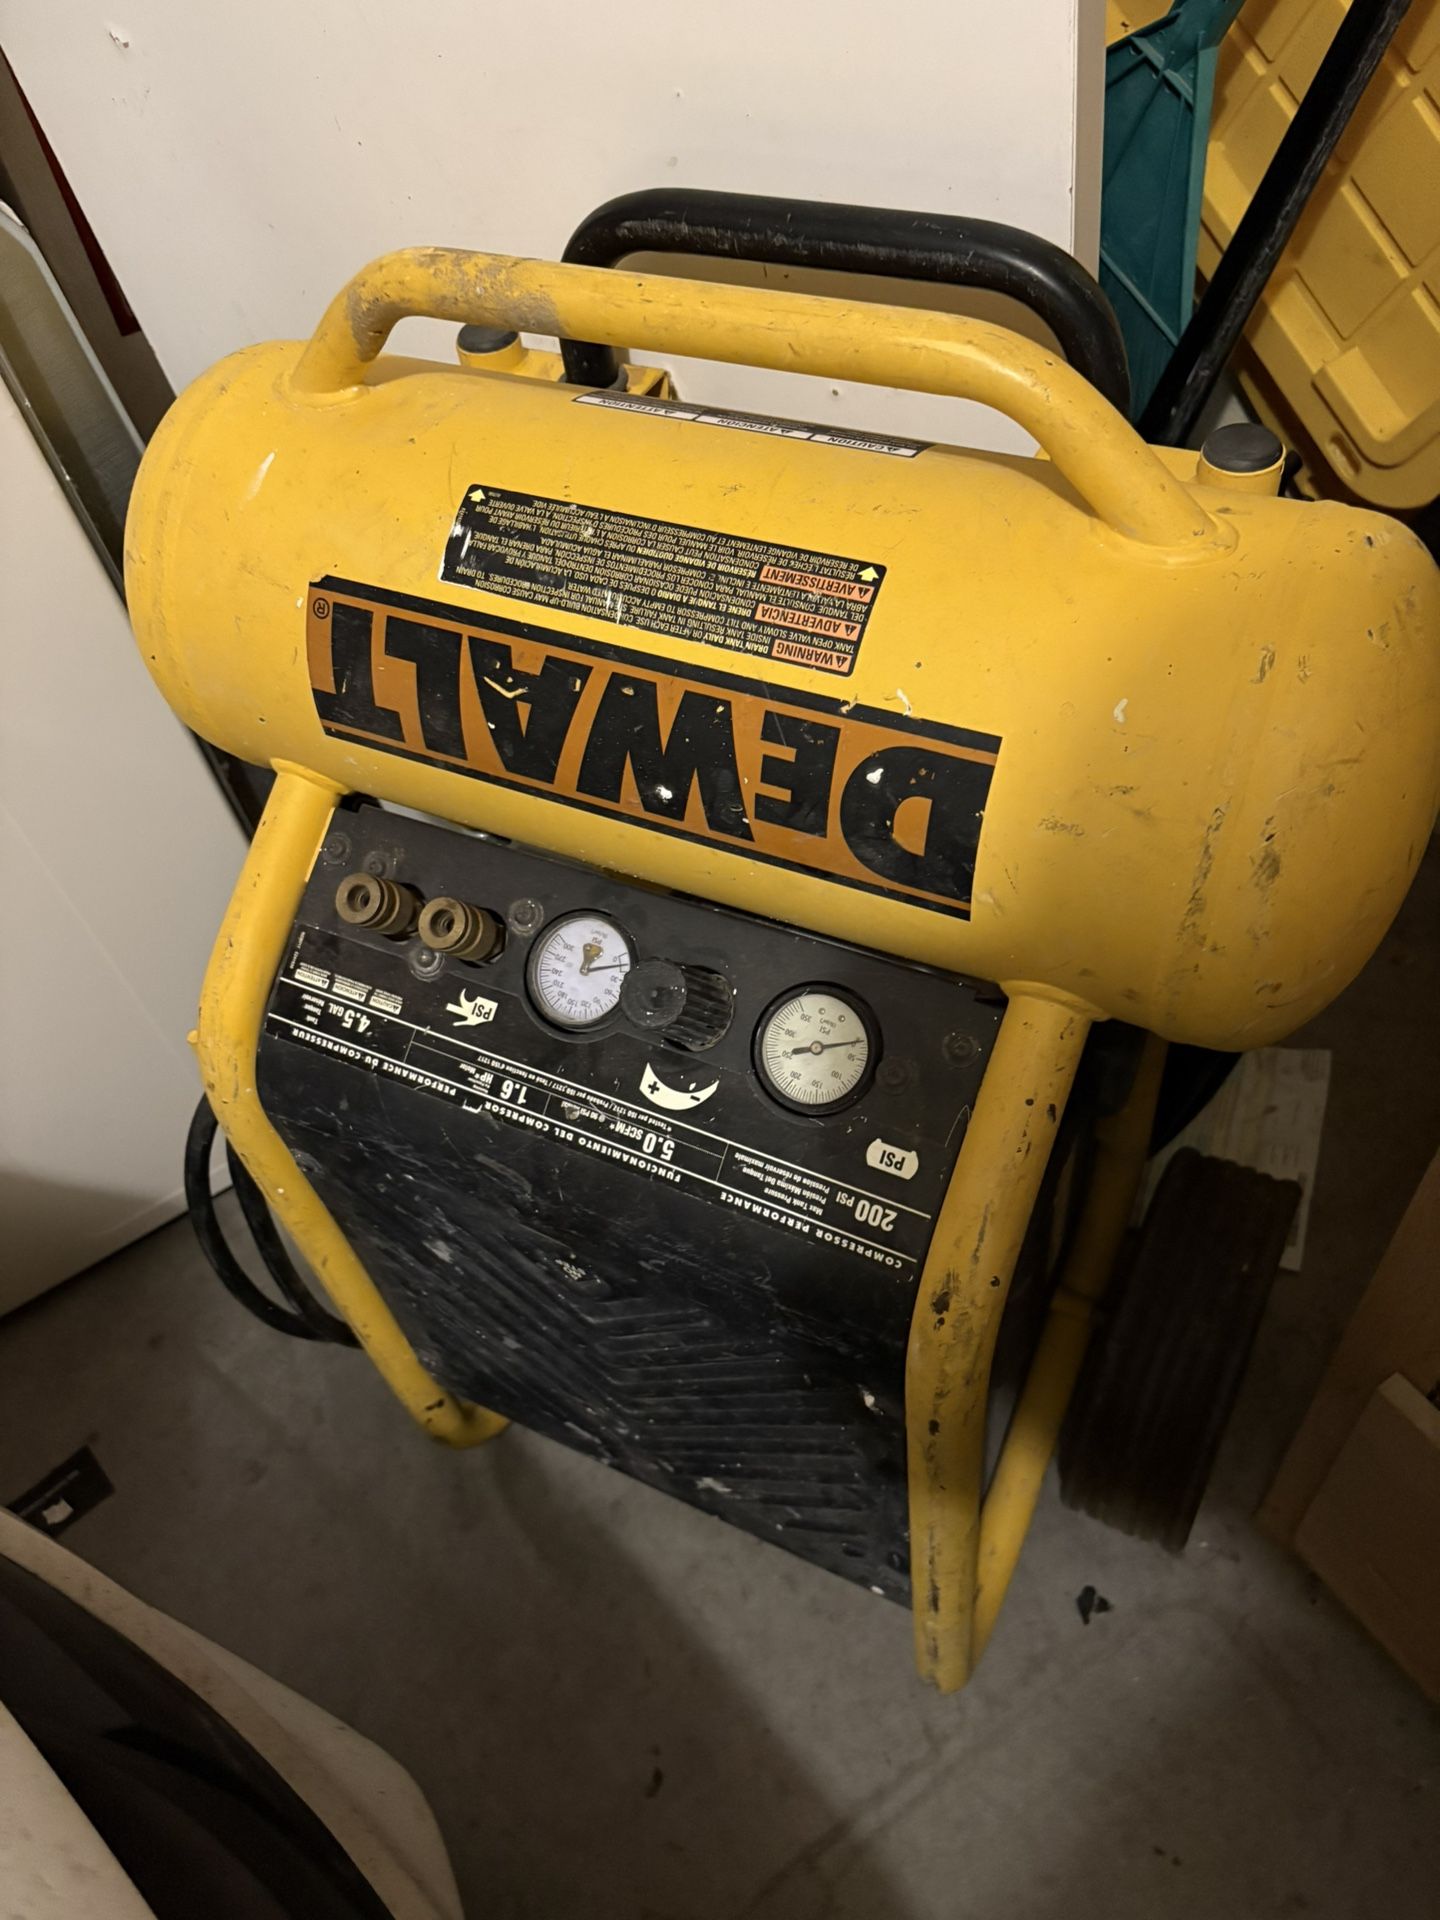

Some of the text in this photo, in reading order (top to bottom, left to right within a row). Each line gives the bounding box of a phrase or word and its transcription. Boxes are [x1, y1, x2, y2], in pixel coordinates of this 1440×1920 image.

[825, 436, 886, 450] CAUTION
[475, 503, 759, 569] CONDENSATION PEUT CAUSER LA CORROSION DU RÉSERVOIR AYANT POUR
[488, 514, 756, 579] RÉSERVOIR DE VIDANGE QUOTIDIEN OU CHAQUE DE
[598, 521, 855, 581] RÉSULTAT DE VOIR LE MANUEL POUR DES PROCÉDURES
[486, 542, 756, 609] CONDENSACIÓN PUEDE OCASIONAR CORROSIÓN DENTRO DEL TANQUE Y PROVOCAR
[499, 536, 864, 622] DEL CONSULTE EL MANUAL PARA CONOCER LOS PROCEDIMIENTOS DE PARA DRENAR EL
[504, 555, 752, 617] DRENE EL A DIARIO O DESPUÉS DE CADA LA ACUMULACIÓN DE
[582, 545, 867, 613] ABRA LA LENTAMENTE E COMPRESOR EL AGUA
[762, 566, 856, 596] AVERTISSEMENT
[455, 565, 771, 644] INSIDE TANK RESULTING IN TANK FOR INSPECTION TO DRAIN
[511, 587, 769, 653] DRAIN TANK DAILY OR EACH BUILD-UP MAY CAUSE
[759, 605, 841, 633] ADVERTENCIA
[640, 598, 855, 653] TANK OPEN VALVE SLOWLY AND TILT COMPRESSOR TO EMPTY
[775, 641, 835, 665] WARNING
[312, 605, 998, 906] DEWALT
[326, 1001, 372, 1035] 4.5 GAL
[371, 997, 393, 1009] CAUTION
[471, 1002, 493, 1019] PSI
[291, 1027, 456, 1096] PERFORMANCE DU COMPRESSEUR
[498, 1077, 530, 1106] 1.6
[483, 1099, 550, 1132] COMPRESOR
[552, 1126, 574, 1141] DEL
[576, 1135, 682, 1183] FUNCIONAMIENTO
[640, 1130, 676, 1161] 5.0
[879, 1149, 907, 1171] PSI
[733, 1151, 830, 1193] Pression de réservoir maximale
[741, 1165, 827, 1204] Presión Máxima Del Tanque
[762, 1186, 823, 1215] Max Tank Pressure
[834, 1190, 898, 1231] 200 PSI
[718, 1190, 903, 1269] COMPRESSOR PERFORMANCE
